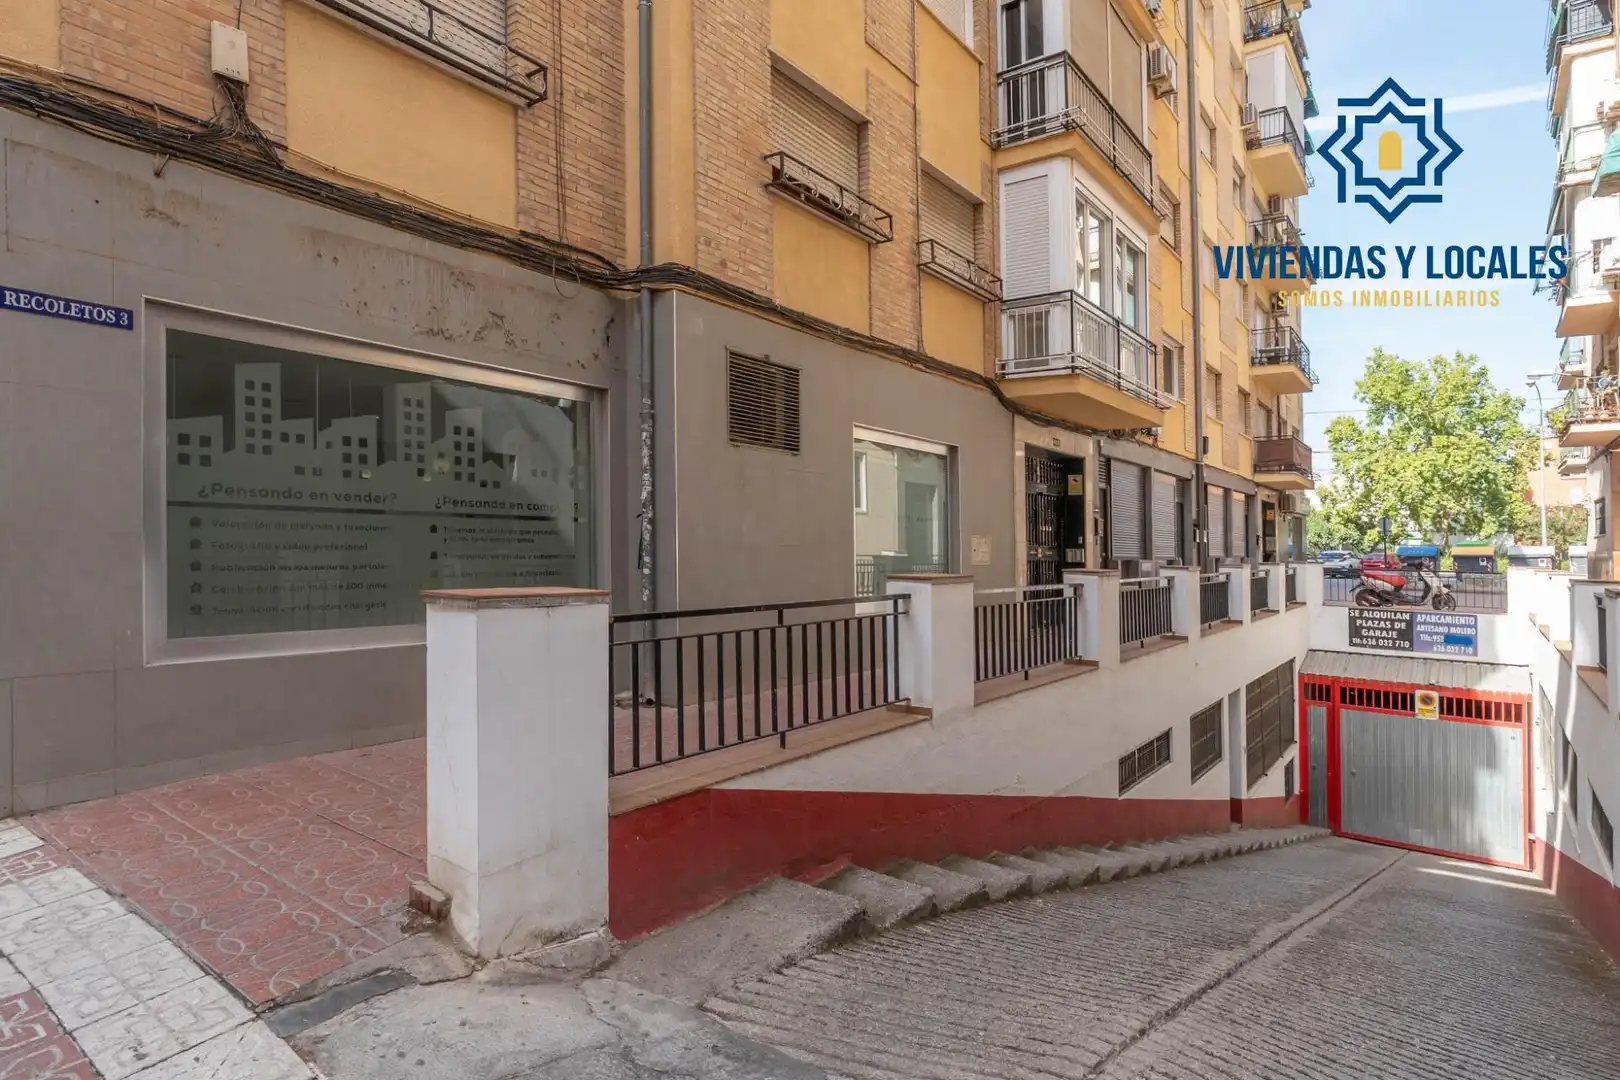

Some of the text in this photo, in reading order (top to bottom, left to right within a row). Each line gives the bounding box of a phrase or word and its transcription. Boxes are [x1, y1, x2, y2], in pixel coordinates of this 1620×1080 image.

[3, 290, 128, 326] RECOLETOS 3
[198, 482, 398, 504] ¿Pensando en vender?
[435, 495, 506, 510] ¿Pensando
[509, 501, 524, 511] en
[1349, 609, 1410, 620] SE ALQUILAN
[1416, 613, 1475, 625] APARCAMIENTO
[1356, 619, 1406, 629] PLAZAS DE
[1361, 629, 1398, 638] GARAJE
[1378, 639, 1393, 647] 032
[1395, 640, 1410, 648] 710
